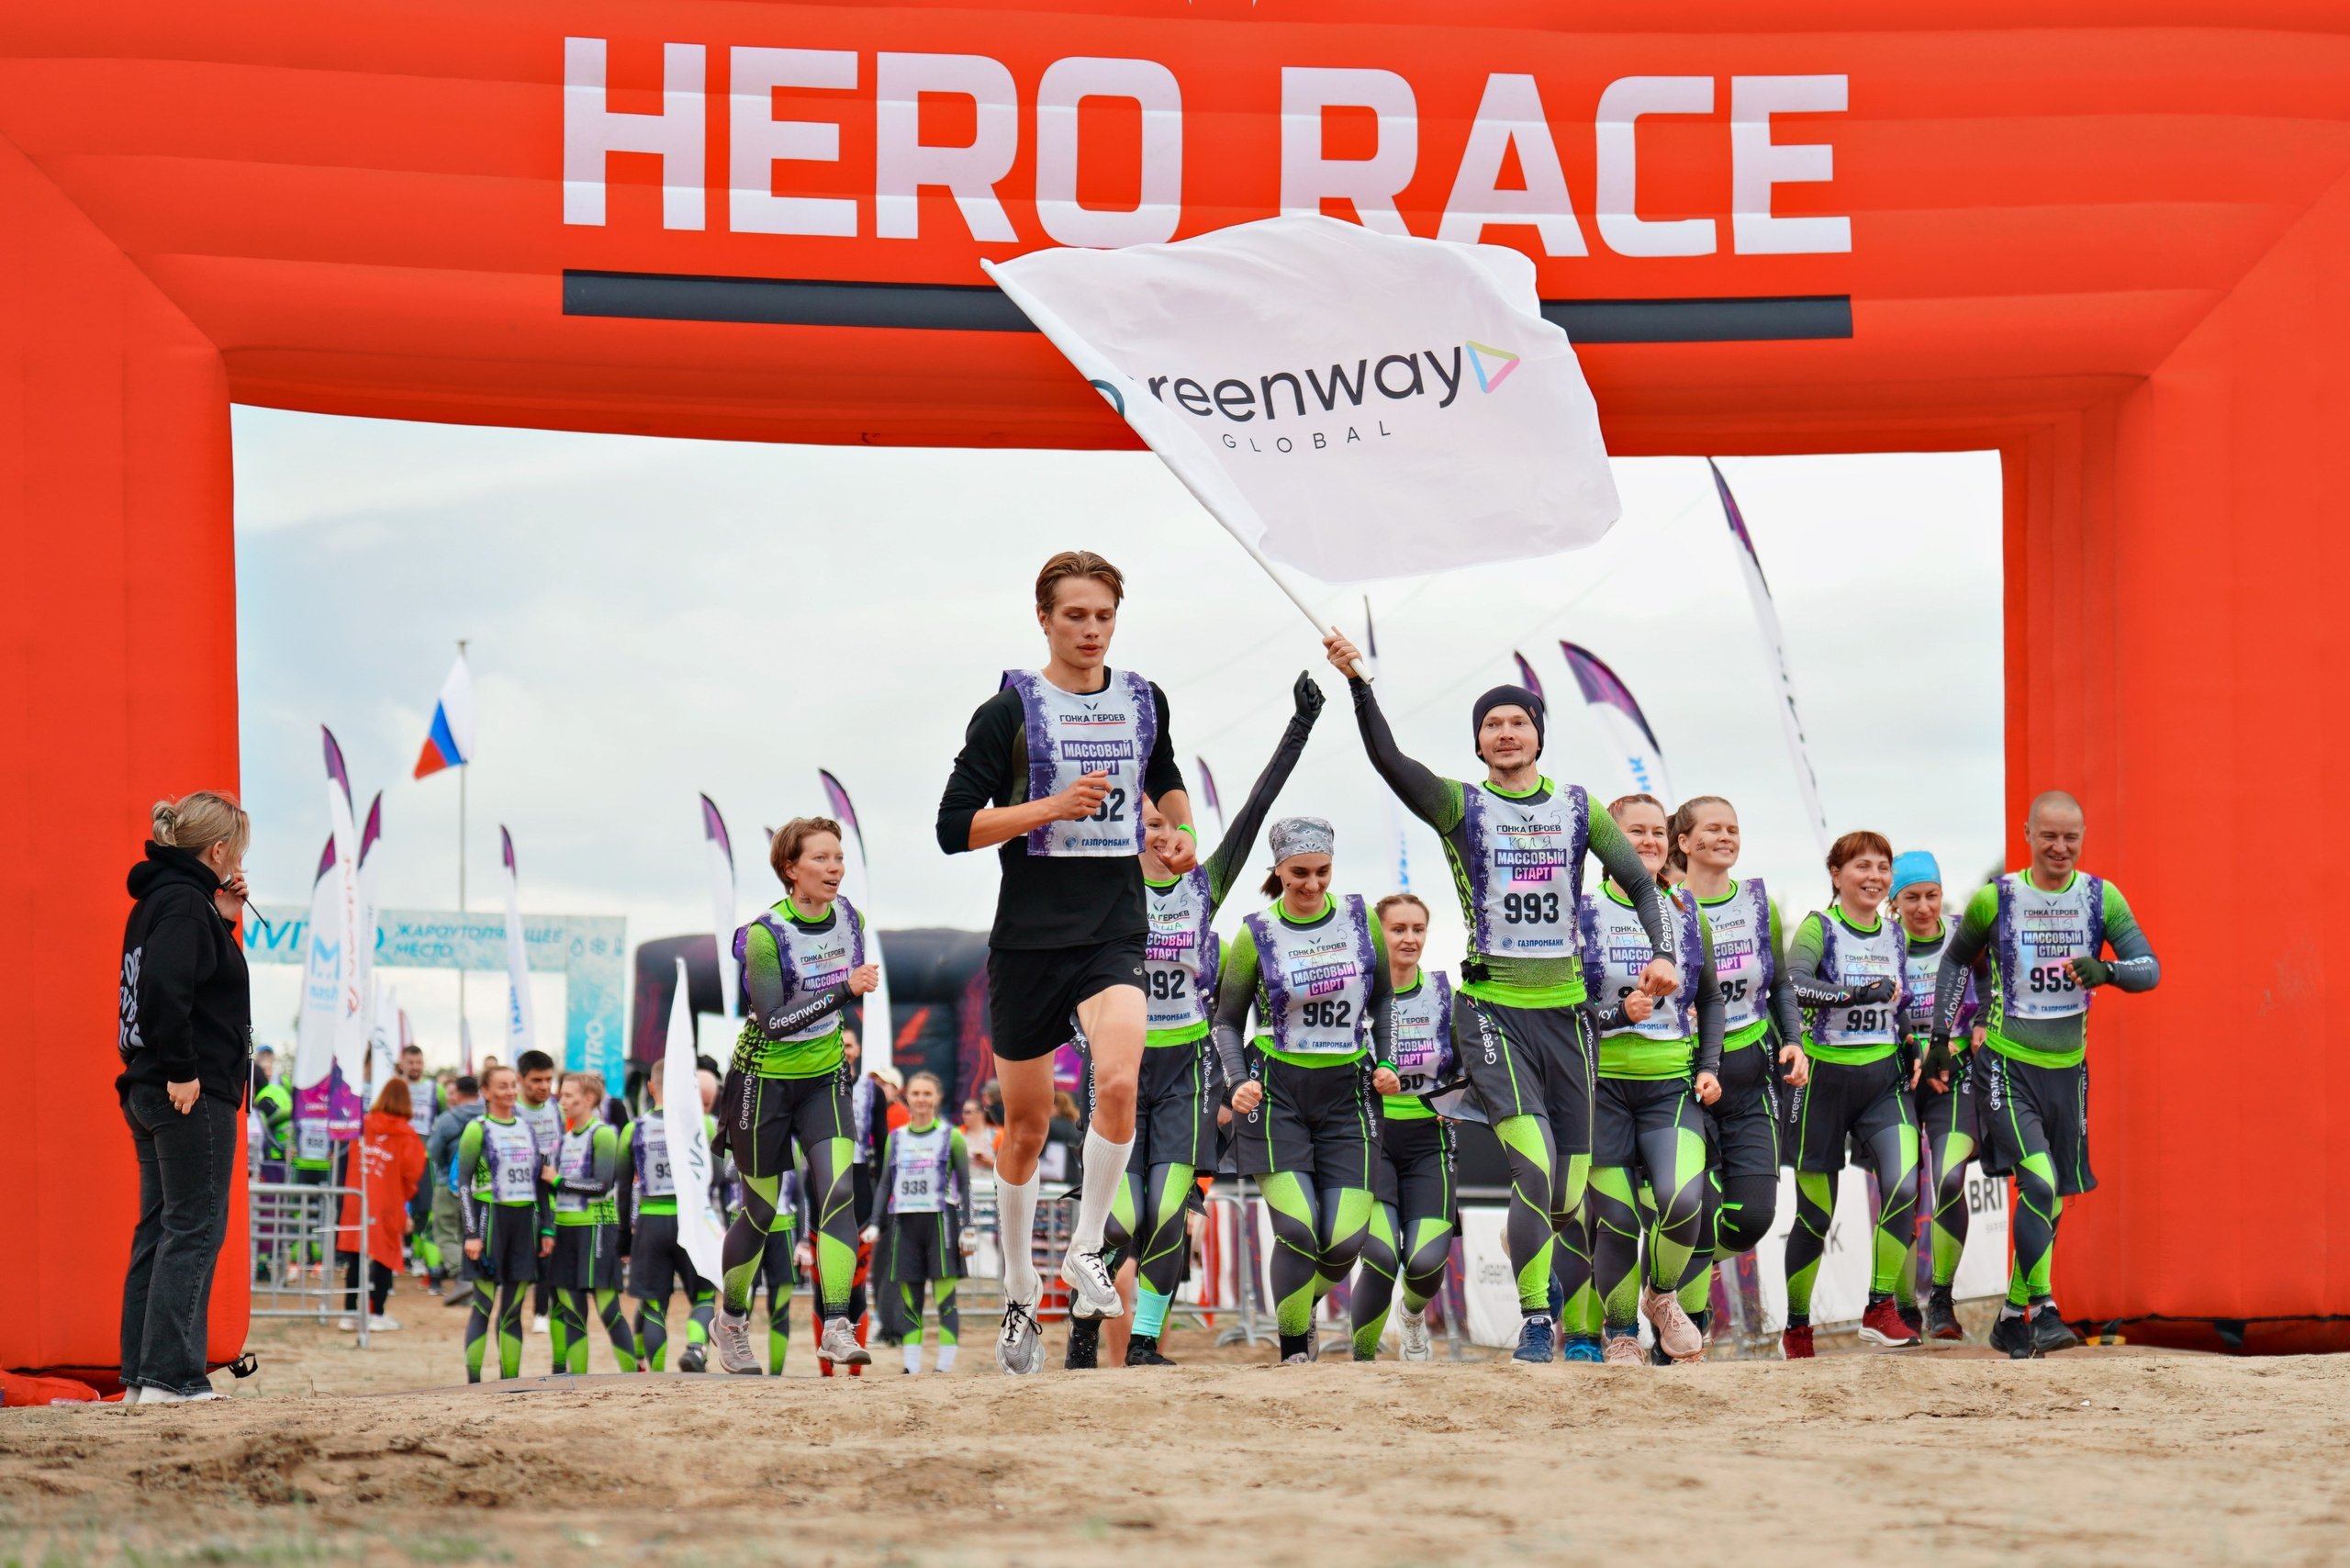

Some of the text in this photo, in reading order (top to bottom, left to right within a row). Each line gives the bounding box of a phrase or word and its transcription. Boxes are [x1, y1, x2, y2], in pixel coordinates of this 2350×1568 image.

[563, 37, 1852, 257] HERO RACE
[1127, 345, 1461, 423] reenway
[1222, 420, 1391, 454] GLOBAL
[1059, 713, 1126, 723] ГОНКА ГЕРОЕВ
[1064, 740, 1132, 758] МАССОВЫЙ
[1082, 760, 1117, 774] СТАРТ
[1496, 823, 1562, 834] ГОНКА ГЕРОЕВ
[1081, 837, 1130, 847] ГАЗПРОМБАНК
[1508, 835, 1553, 850] КОЛЯ
[1497, 848, 1565, 865] МАССОВЫЙ
[1515, 867, 1550, 880] СТАРТ
[1158, 910, 1190, 922] ГЕРОЕВ
[1504, 892, 1560, 924] 993
[1656, 888, 1673, 953] Greenway
[1715, 919, 1746, 931] ГЕРОЕВ
[2025, 918, 2075, 930] САНЯ
[395, 923, 564, 944] ЖАРОУТОЛЯЩЕЕ
[1147, 931, 1193, 946] ССОВЫЙ
[1337, 923, 1348, 940] 5
[2024, 931, 2082, 944] МАССОВЫЙ
[394, 942, 453, 958] МЕСТО
[1288, 942, 1347, 958] ГОНКА ГЕРОЕВ
[1517, 938, 1564, 947] ГАЗПРОМБАНК
[1714, 940, 1751, 958] СОВЫЙ
[800, 947, 845, 963] ГОНКА ГЕРОЕВ
[1612, 949, 1652, 961] МАССО
[2038, 945, 2069, 957] СТАРТ
[1715, 957, 1739, 971] ТАРТ
[803, 969, 848, 991] МАССОВЫЙ
[1293, 961, 1355, 985] МАССОВЫЙ
[1147, 969, 1186, 1001] 92
[1310, 980, 1342, 995] СТАРТ
[1719, 979, 1748, 1006] 95
[1944, 966, 1969, 1019] eenway
[1793, 984, 1841, 1003] eenway
[769, 996, 827, 1030] Greenway
[1303, 1000, 1351, 1028] 962
[1402, 1016, 1429, 1025] ГЕРОЕВ
[1726, 1014, 1748, 1024] РОМБАНК
[1846, 1009, 1887, 1033] 991
[1388, 1007, 1399, 1065] Greenway
[1478, 1013, 1497, 1065] Greenw
[1398, 1037, 1433, 1052] СОВЫЙ
[1399, 1053, 1421, 1066] ТАРТ
[738, 1074, 755, 1131] Greenway
[901, 1181, 928, 1195] 938
